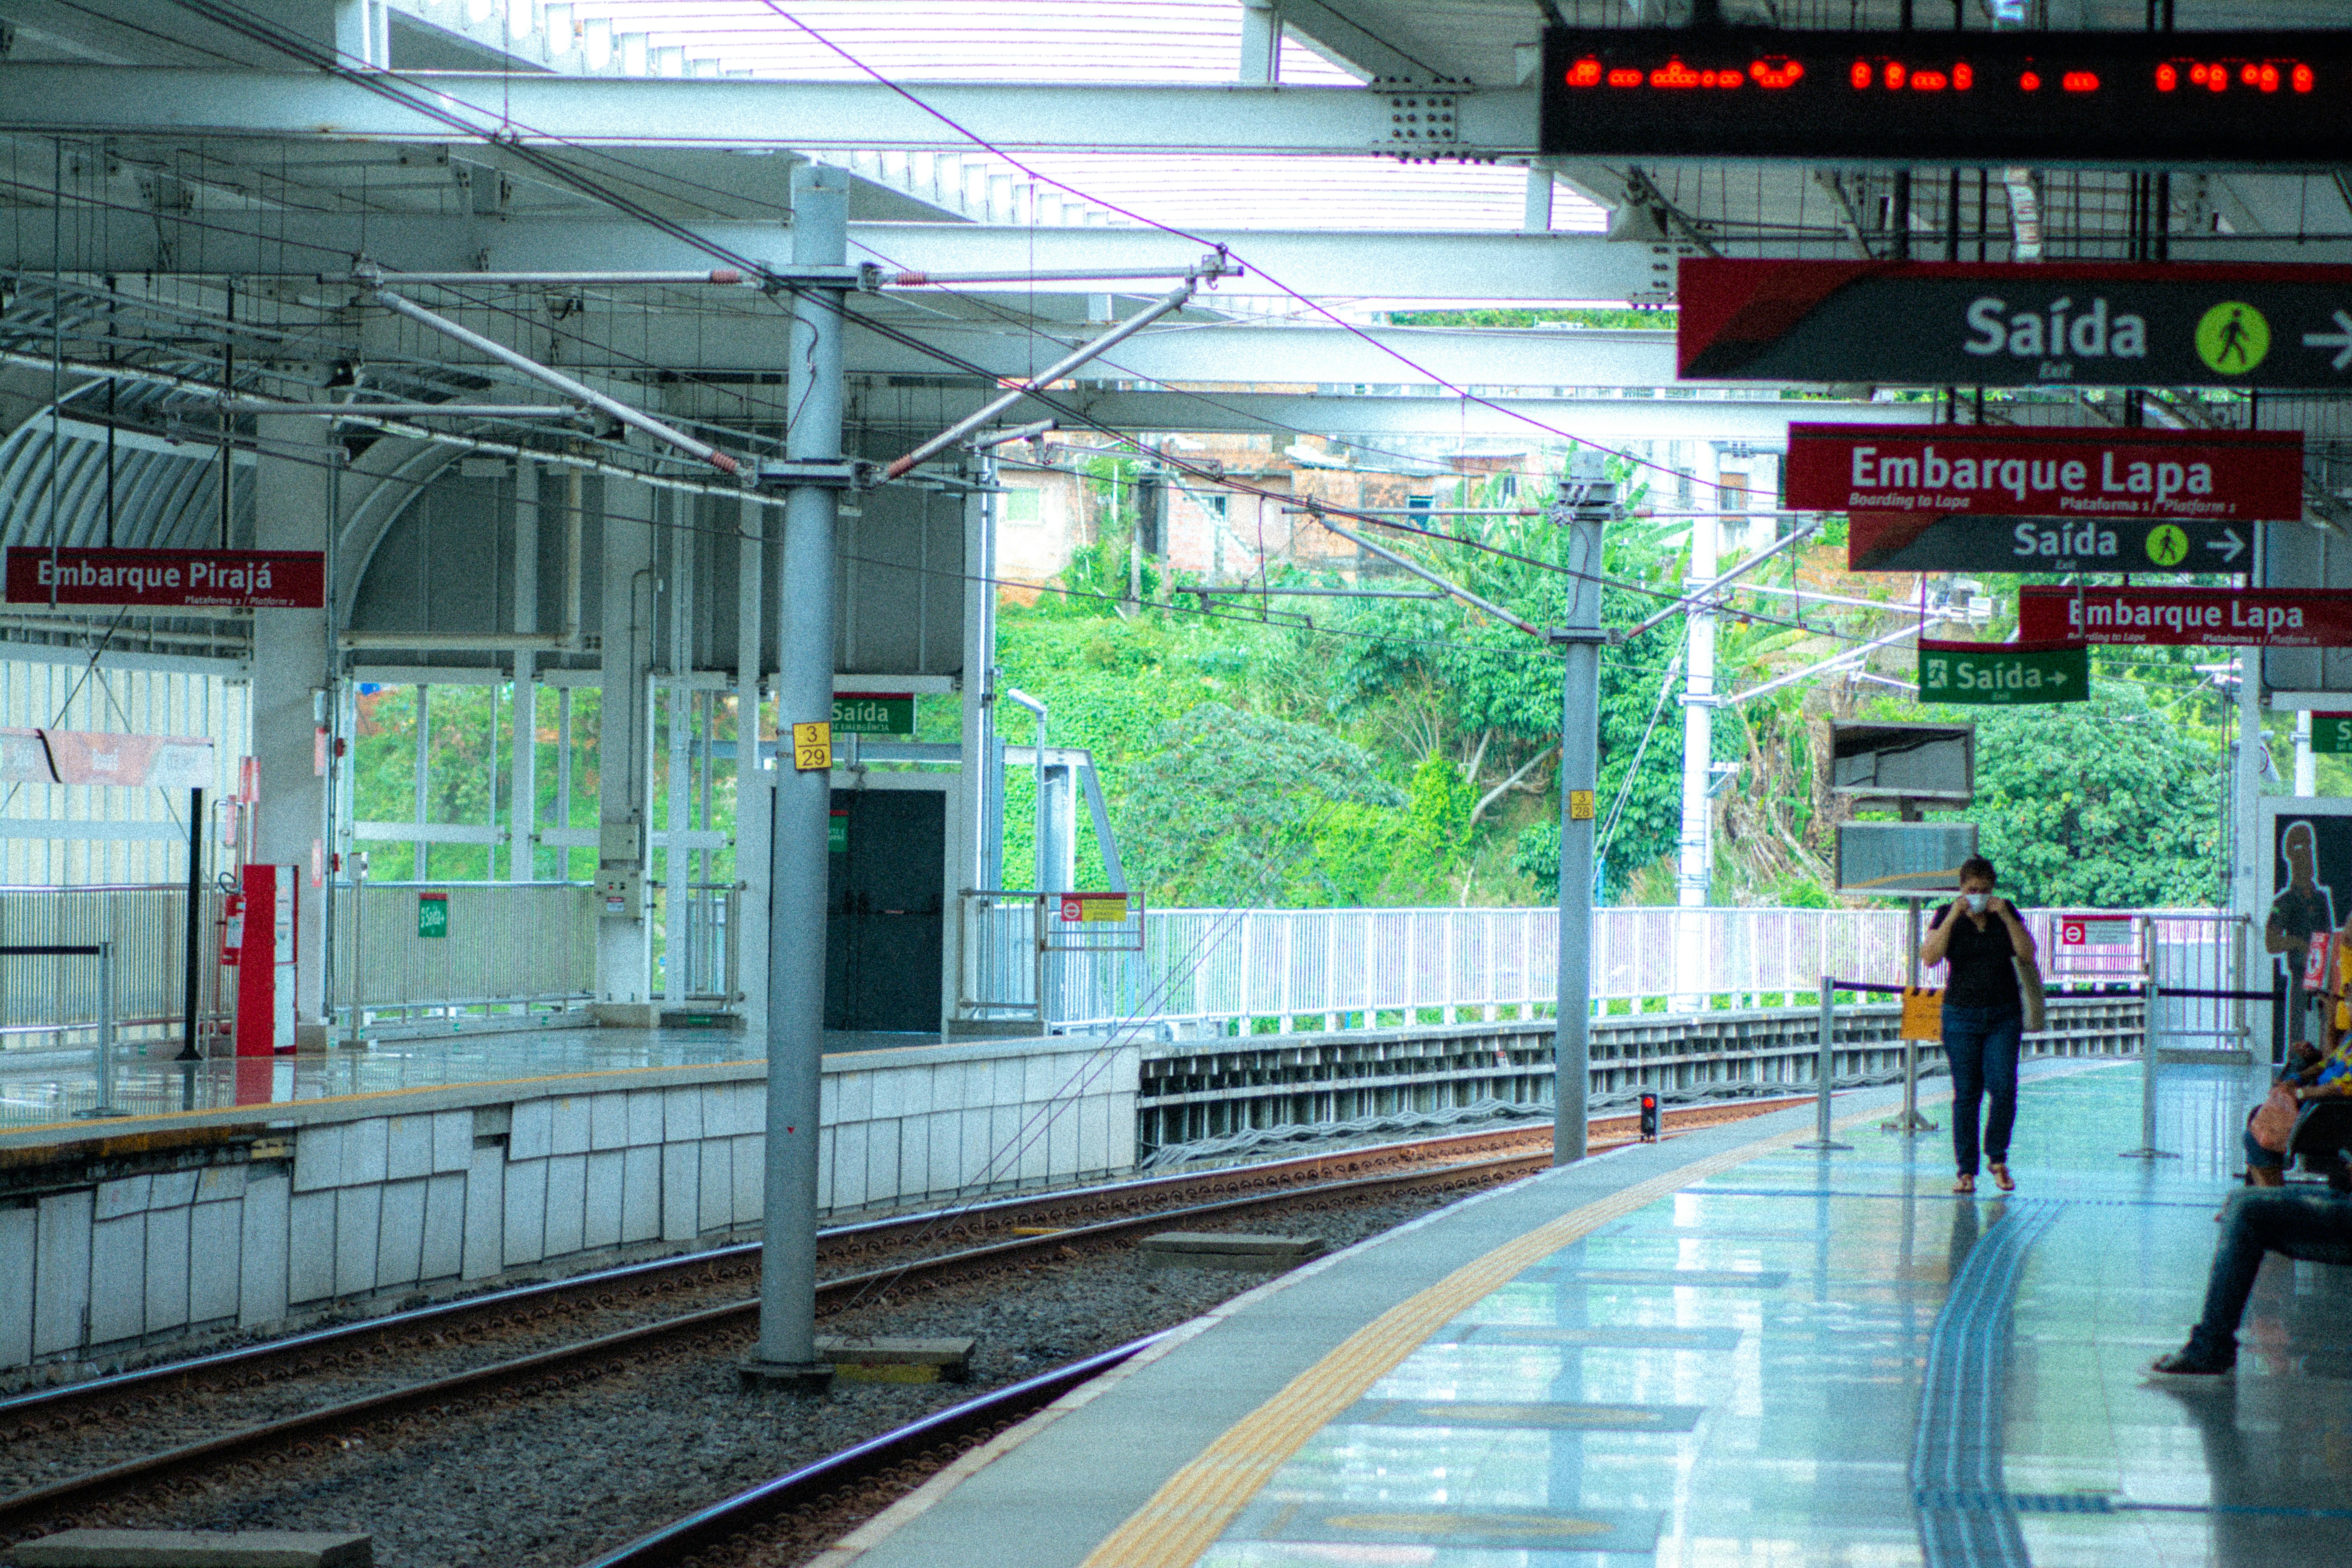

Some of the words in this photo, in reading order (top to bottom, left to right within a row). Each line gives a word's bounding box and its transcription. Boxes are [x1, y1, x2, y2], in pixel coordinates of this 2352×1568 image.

[1963, 296, 2147, 358] Saída
[2039, 361, 2073, 379] Exit
[1851, 446, 2087, 501] Embarque
[2102, 451, 2213, 504] Lapa
[1848, 492, 1915, 510] Boarding
[1918, 494, 1933, 507] to
[2060, 496, 2139, 511] Plataforma
[2163, 498, 2225, 515] Platform
[2014, 522, 2118, 555] Saída
[2055, 559, 2077, 570] Exit
[38, 559, 181, 593] Embarque
[189, 561, 272, 595] Pirajá
[185, 595, 232, 605] Plataforma
[249, 596, 288, 606] Platform
[2069, 598, 2222, 633] Embarque
[2232, 600, 2305, 634] Lapa
[2112, 632, 2122, 642] to
[2203, 633, 2254, 644] Plataforma
[2270, 634, 2310, 645] Platform
[1956, 662, 2043, 690] Saída
[832, 702, 889, 722] Saída
[806, 726, 817, 742] 3
[841, 722, 889, 731] EMERGÊNCIA
[802, 749, 825, 766] 29
[1579, 792, 1586, 803] 3
[1575, 806, 1590, 817] 28
